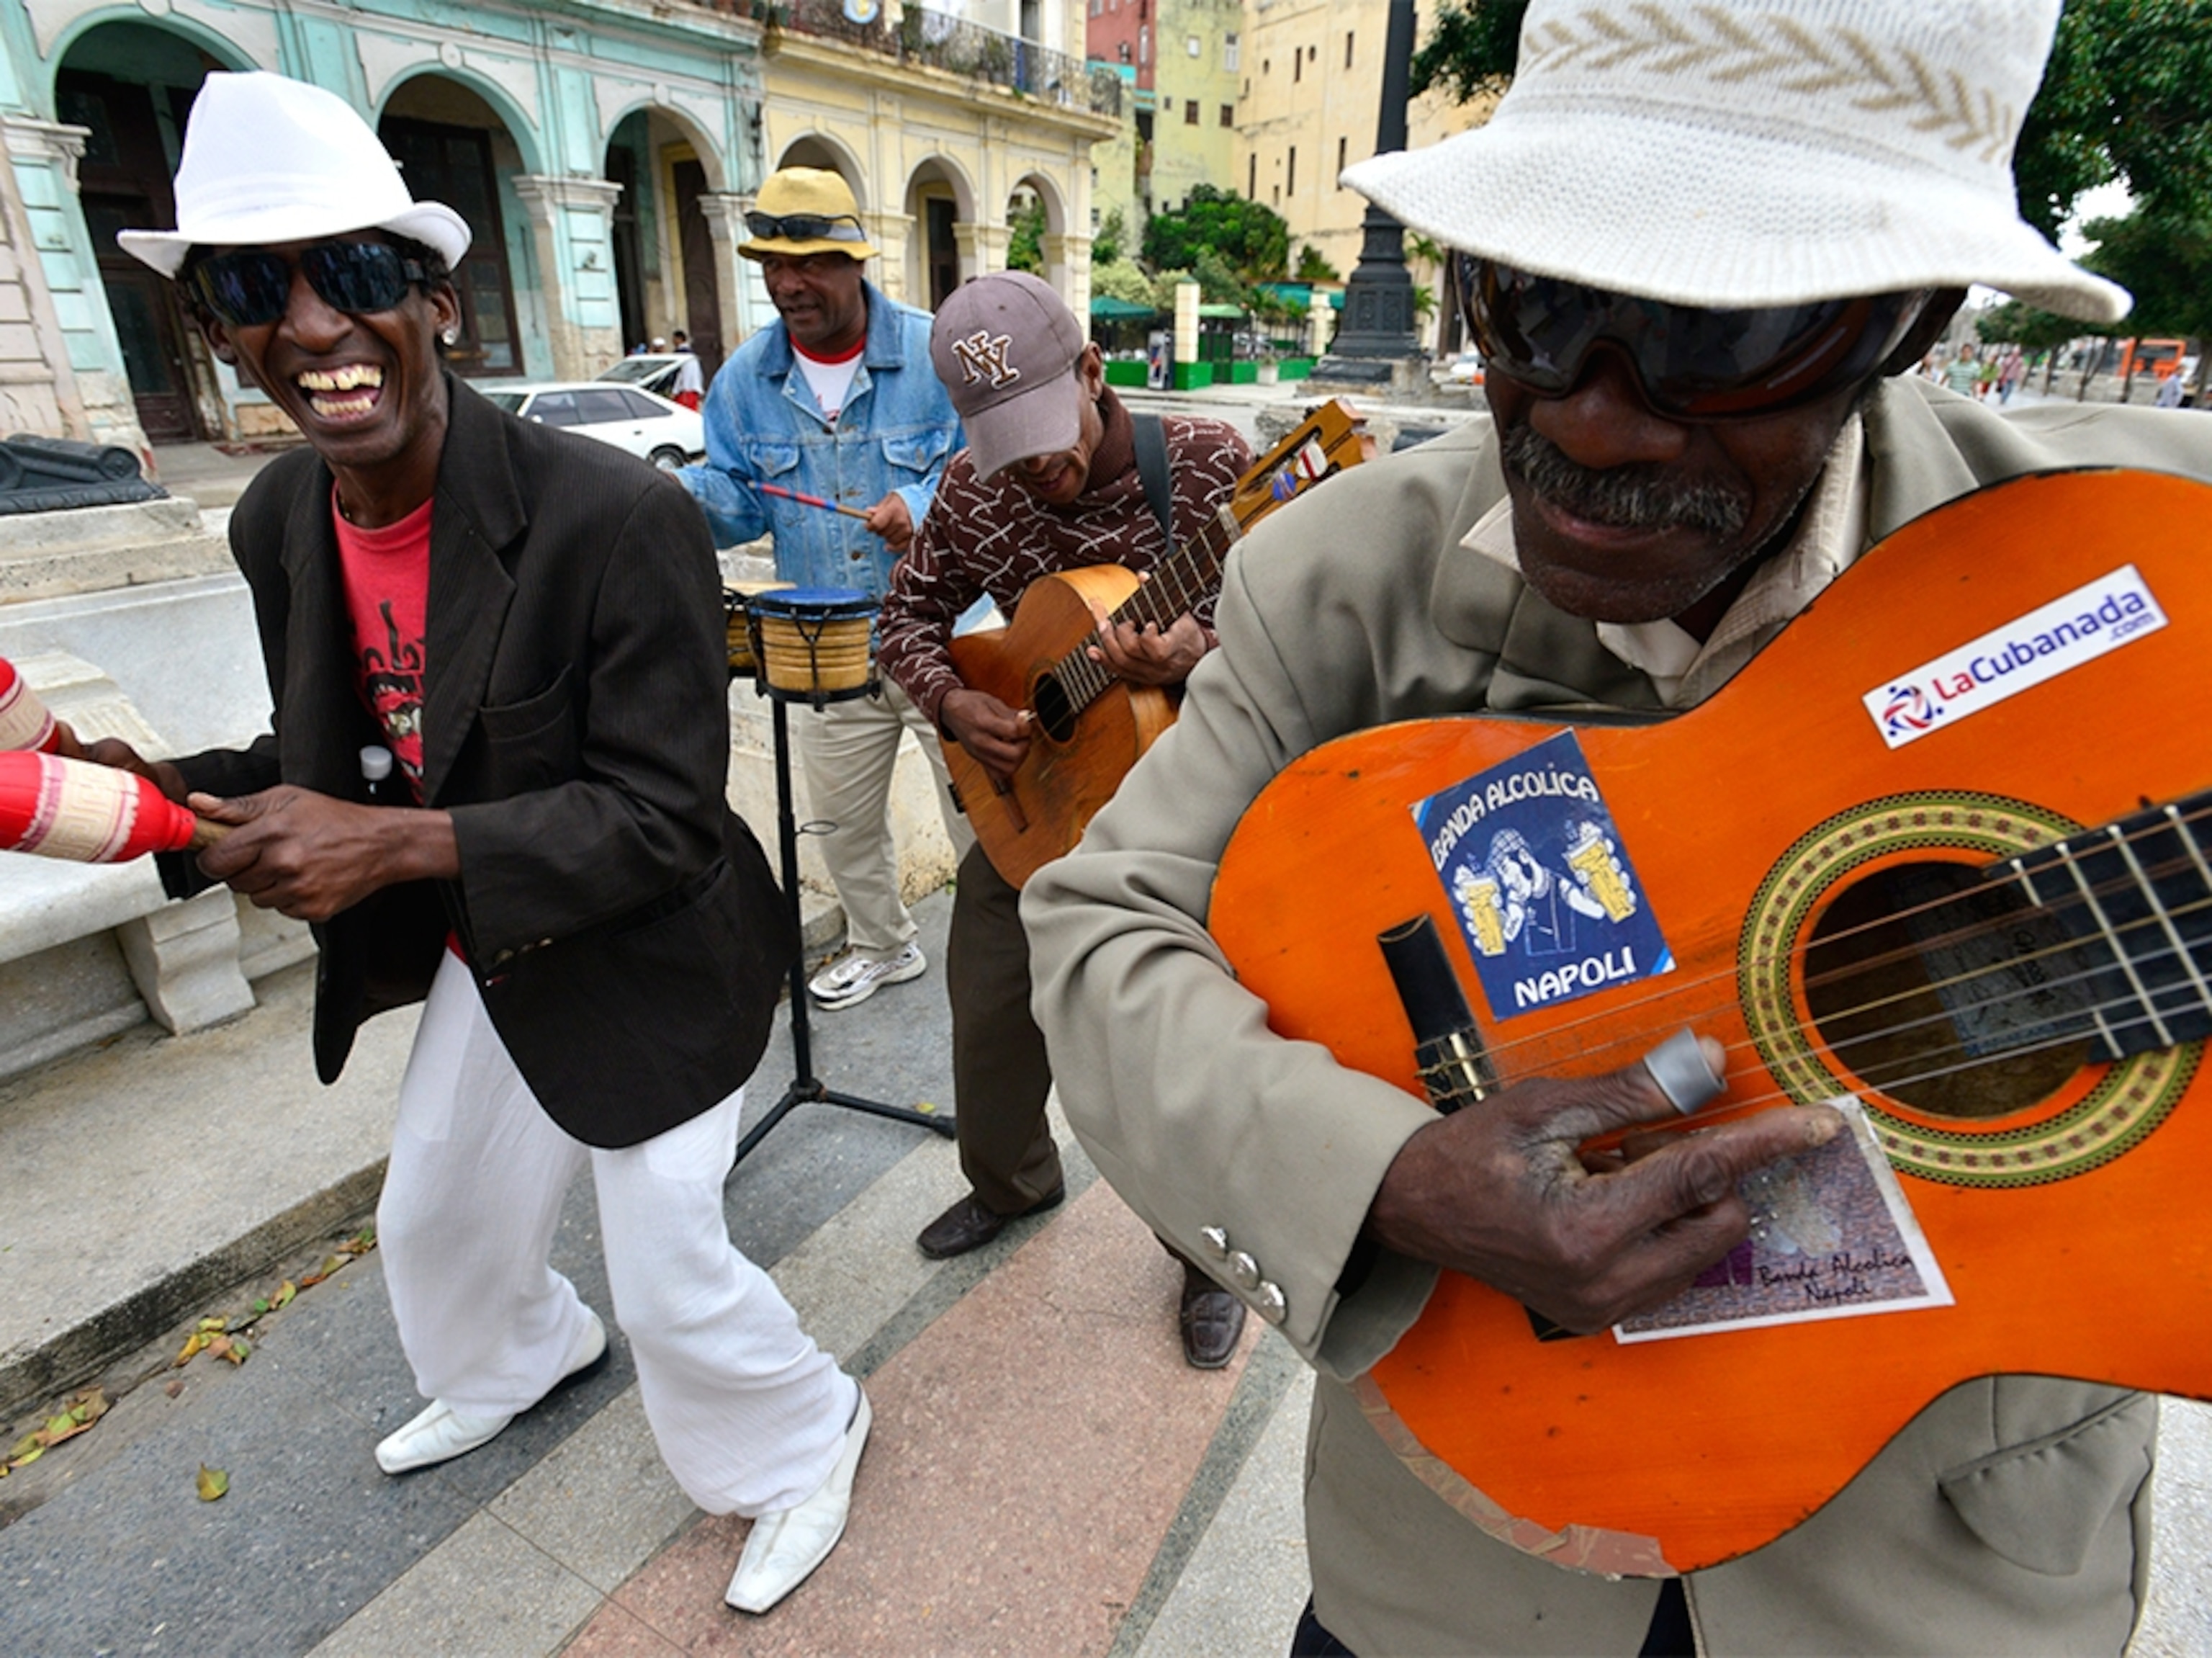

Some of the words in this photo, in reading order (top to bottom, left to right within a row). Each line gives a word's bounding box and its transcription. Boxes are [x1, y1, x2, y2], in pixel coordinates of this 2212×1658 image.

[951, 330, 1021, 390] NY
[1932, 590, 2146, 702] LaCubanada
[1431, 793, 1486, 873] BANDA
[1514, 946, 1637, 1008] NAPOLI
[1756, 1262, 1820, 1287] Banda
[1804, 1276, 1871, 1305] Napoli
